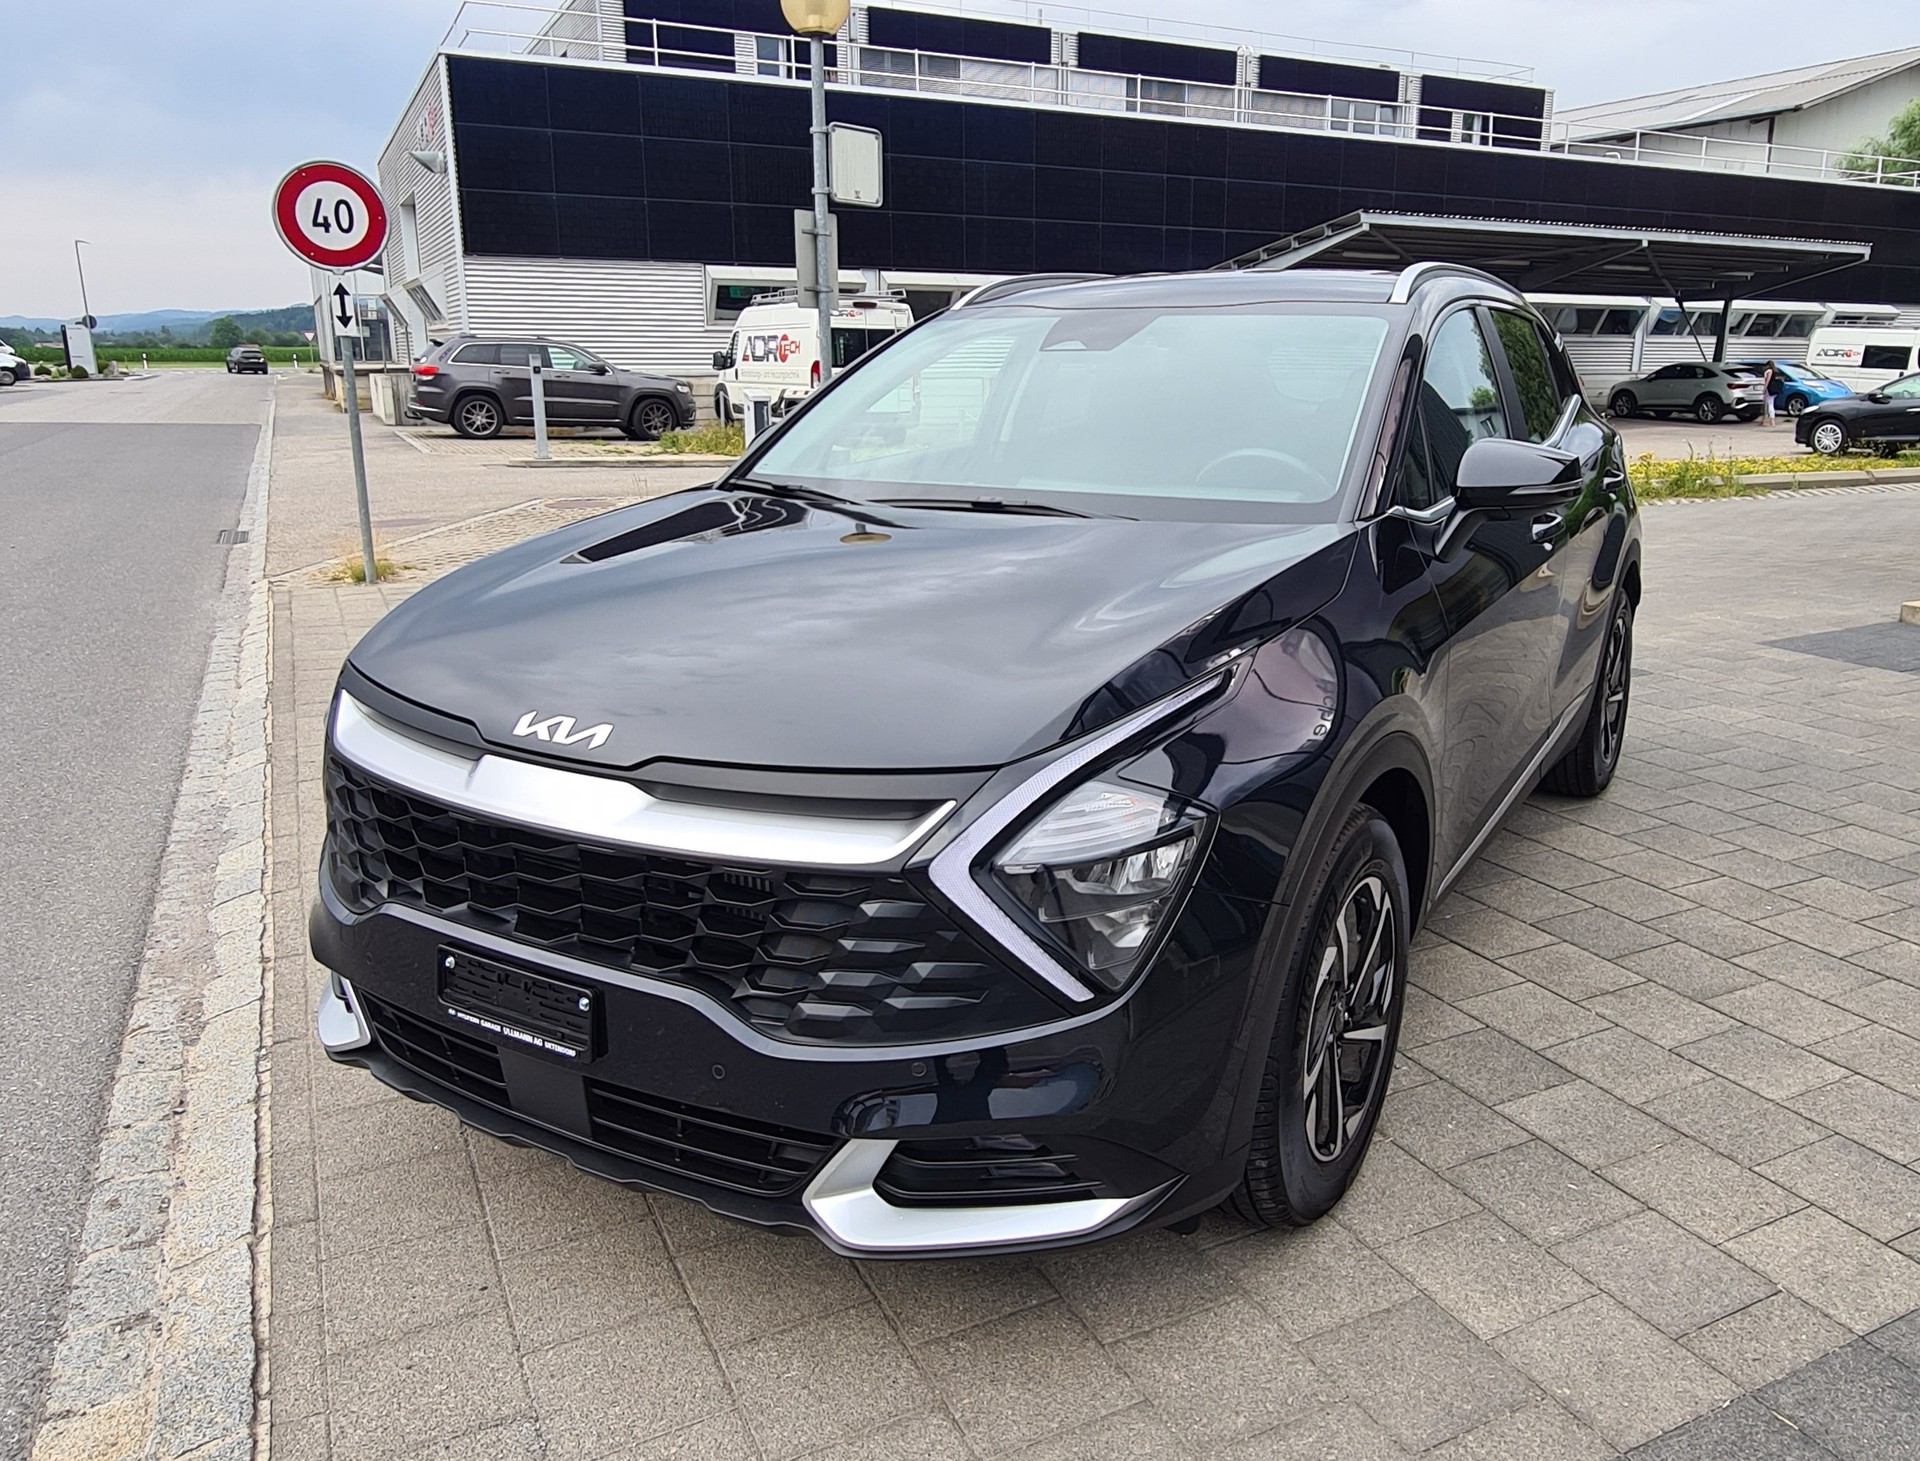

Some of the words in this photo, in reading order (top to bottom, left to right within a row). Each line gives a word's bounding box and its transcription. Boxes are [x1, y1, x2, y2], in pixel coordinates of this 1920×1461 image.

[312, 198, 354, 234] 40
[512, 710, 614, 750] KIA
[503, 1027, 533, 1043] ULLMANN
[533, 1036, 543, 1046] AG
